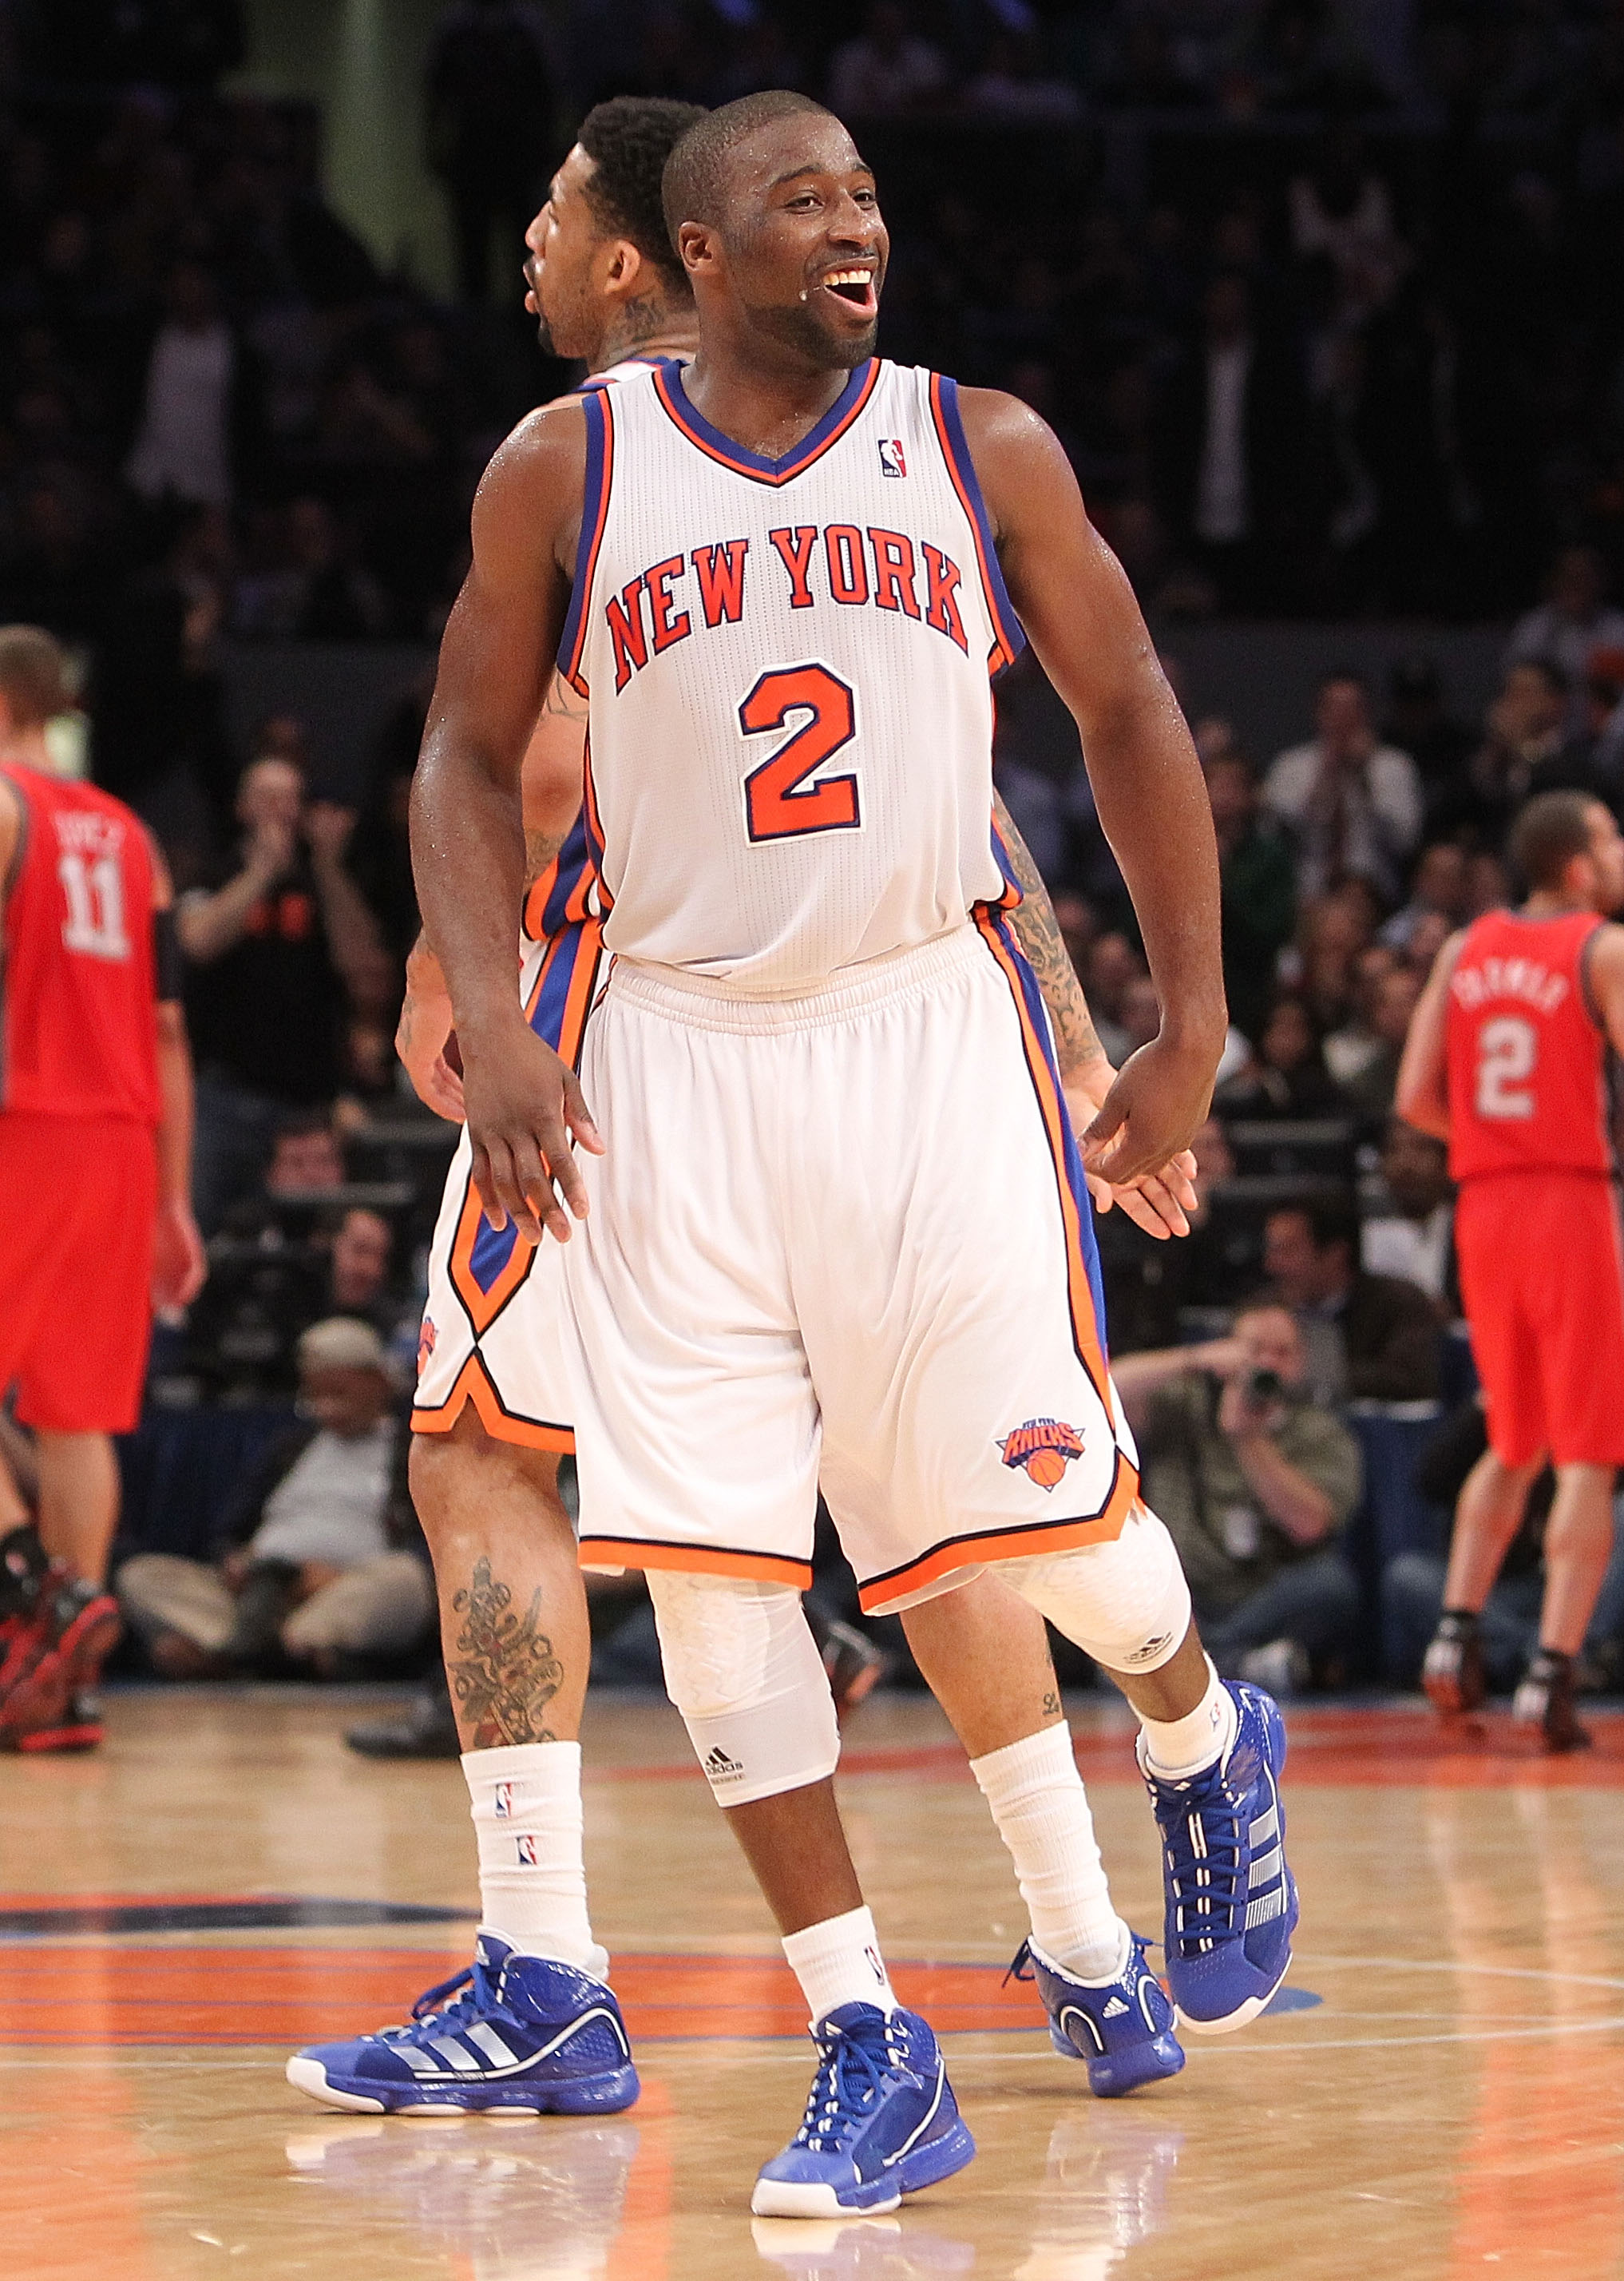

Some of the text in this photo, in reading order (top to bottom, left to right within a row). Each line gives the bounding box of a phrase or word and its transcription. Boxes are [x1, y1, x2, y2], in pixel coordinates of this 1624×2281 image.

[604, 524, 969, 697] NEW YORK
[737, 662, 862, 844] 2
[61, 855, 129, 958] 11
[1477, 1016, 1535, 1117] 2
[1002, 1422, 1085, 1465] KNICKS
